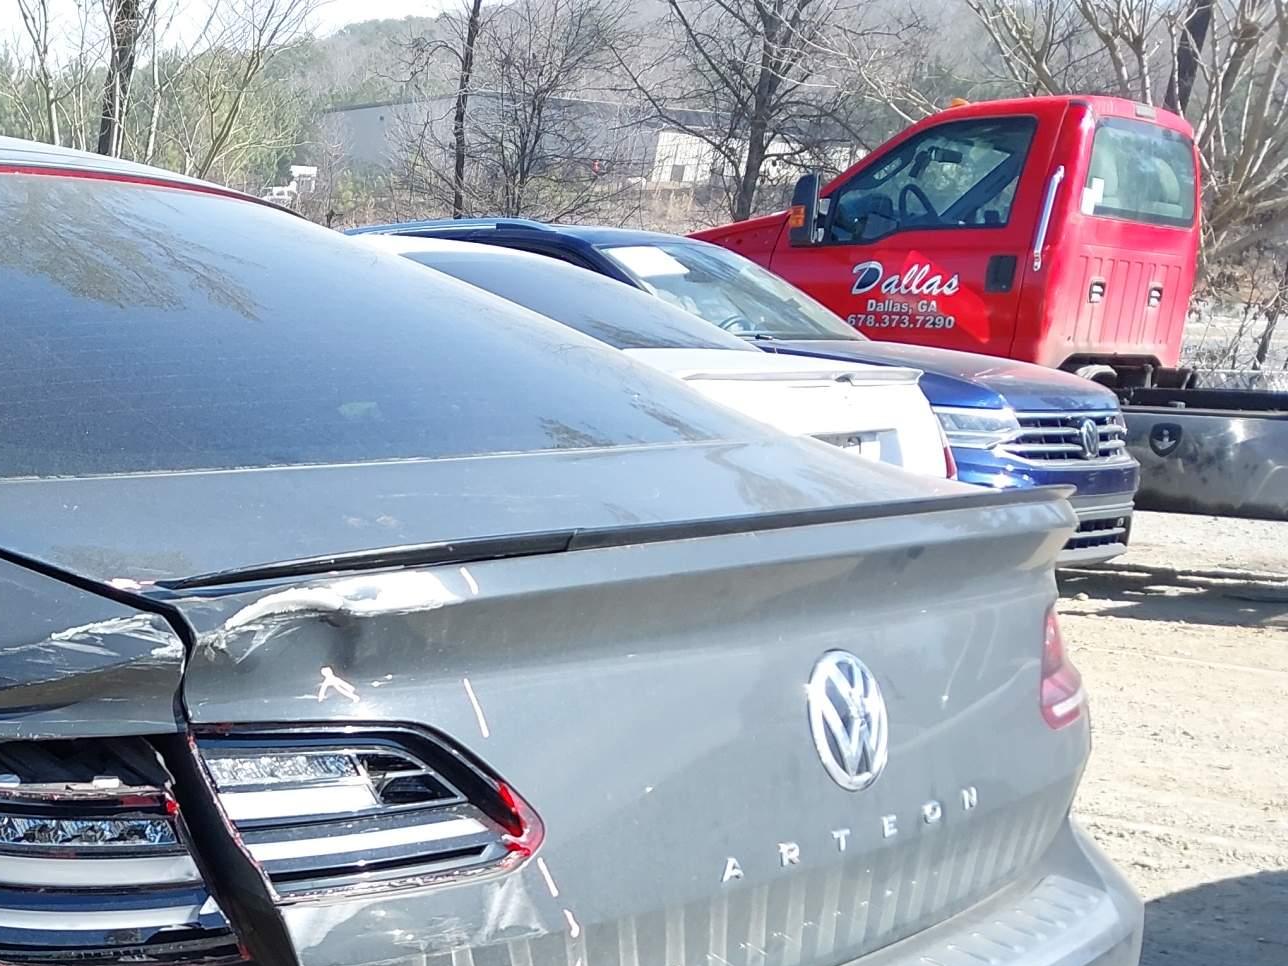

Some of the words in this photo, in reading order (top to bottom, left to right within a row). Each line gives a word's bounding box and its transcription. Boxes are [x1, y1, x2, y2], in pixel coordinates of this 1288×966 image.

[851, 261, 959, 295] Dallas
[867, 299, 913, 315] Dallas,
[918, 300, 938, 313] GA
[848, 314, 955, 329] 678.373.7290
[721, 786, 978, 882] ARTEON
